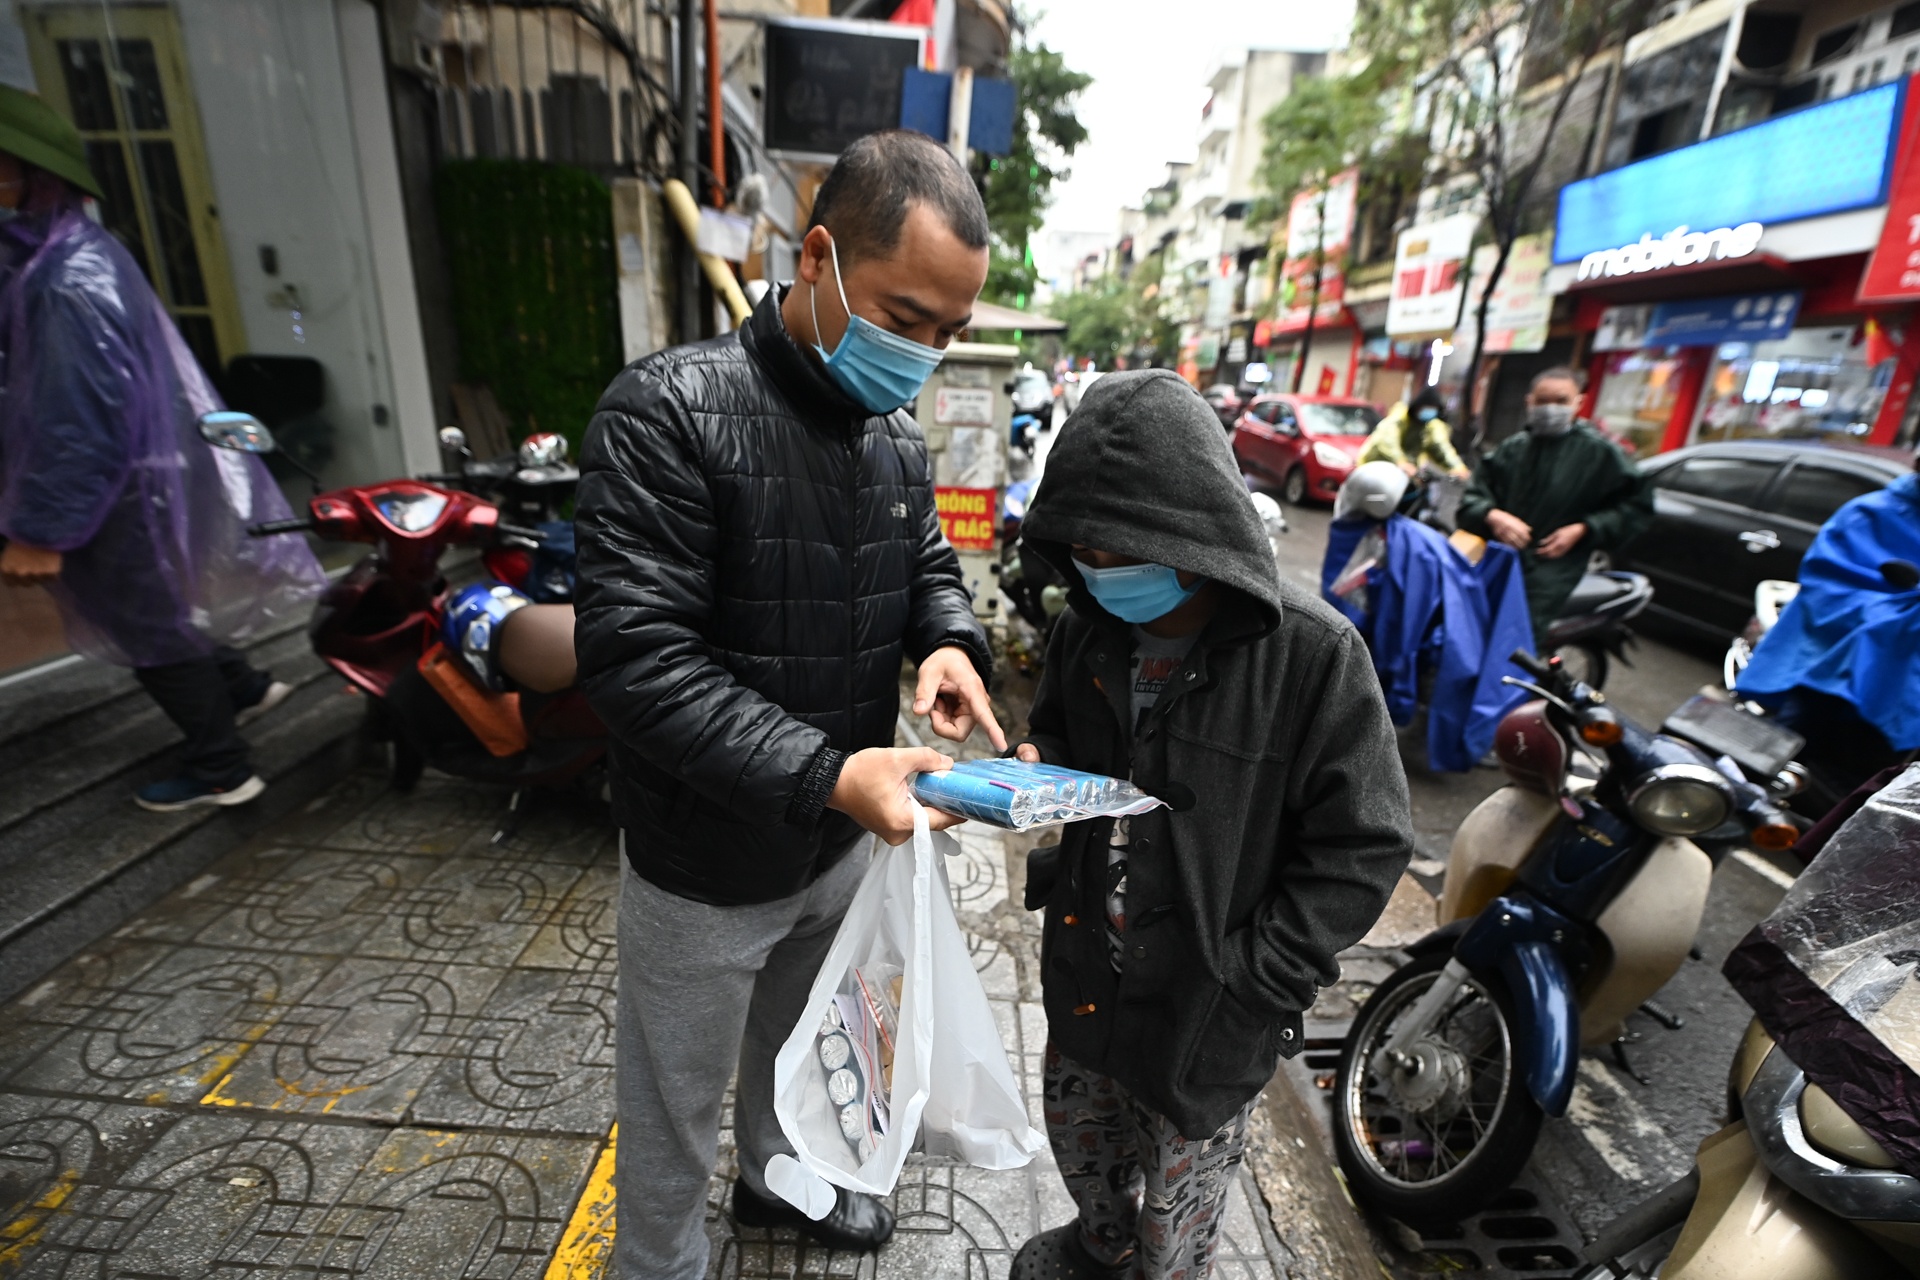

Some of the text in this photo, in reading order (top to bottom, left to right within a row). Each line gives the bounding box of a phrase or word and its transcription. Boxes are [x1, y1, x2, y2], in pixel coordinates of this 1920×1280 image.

[1577, 222, 1764, 282] mobifone
[935, 490, 986, 514] HÔNG
[954, 516, 992, 540] RÁC
[1136, 684, 1162, 693] INVAD
